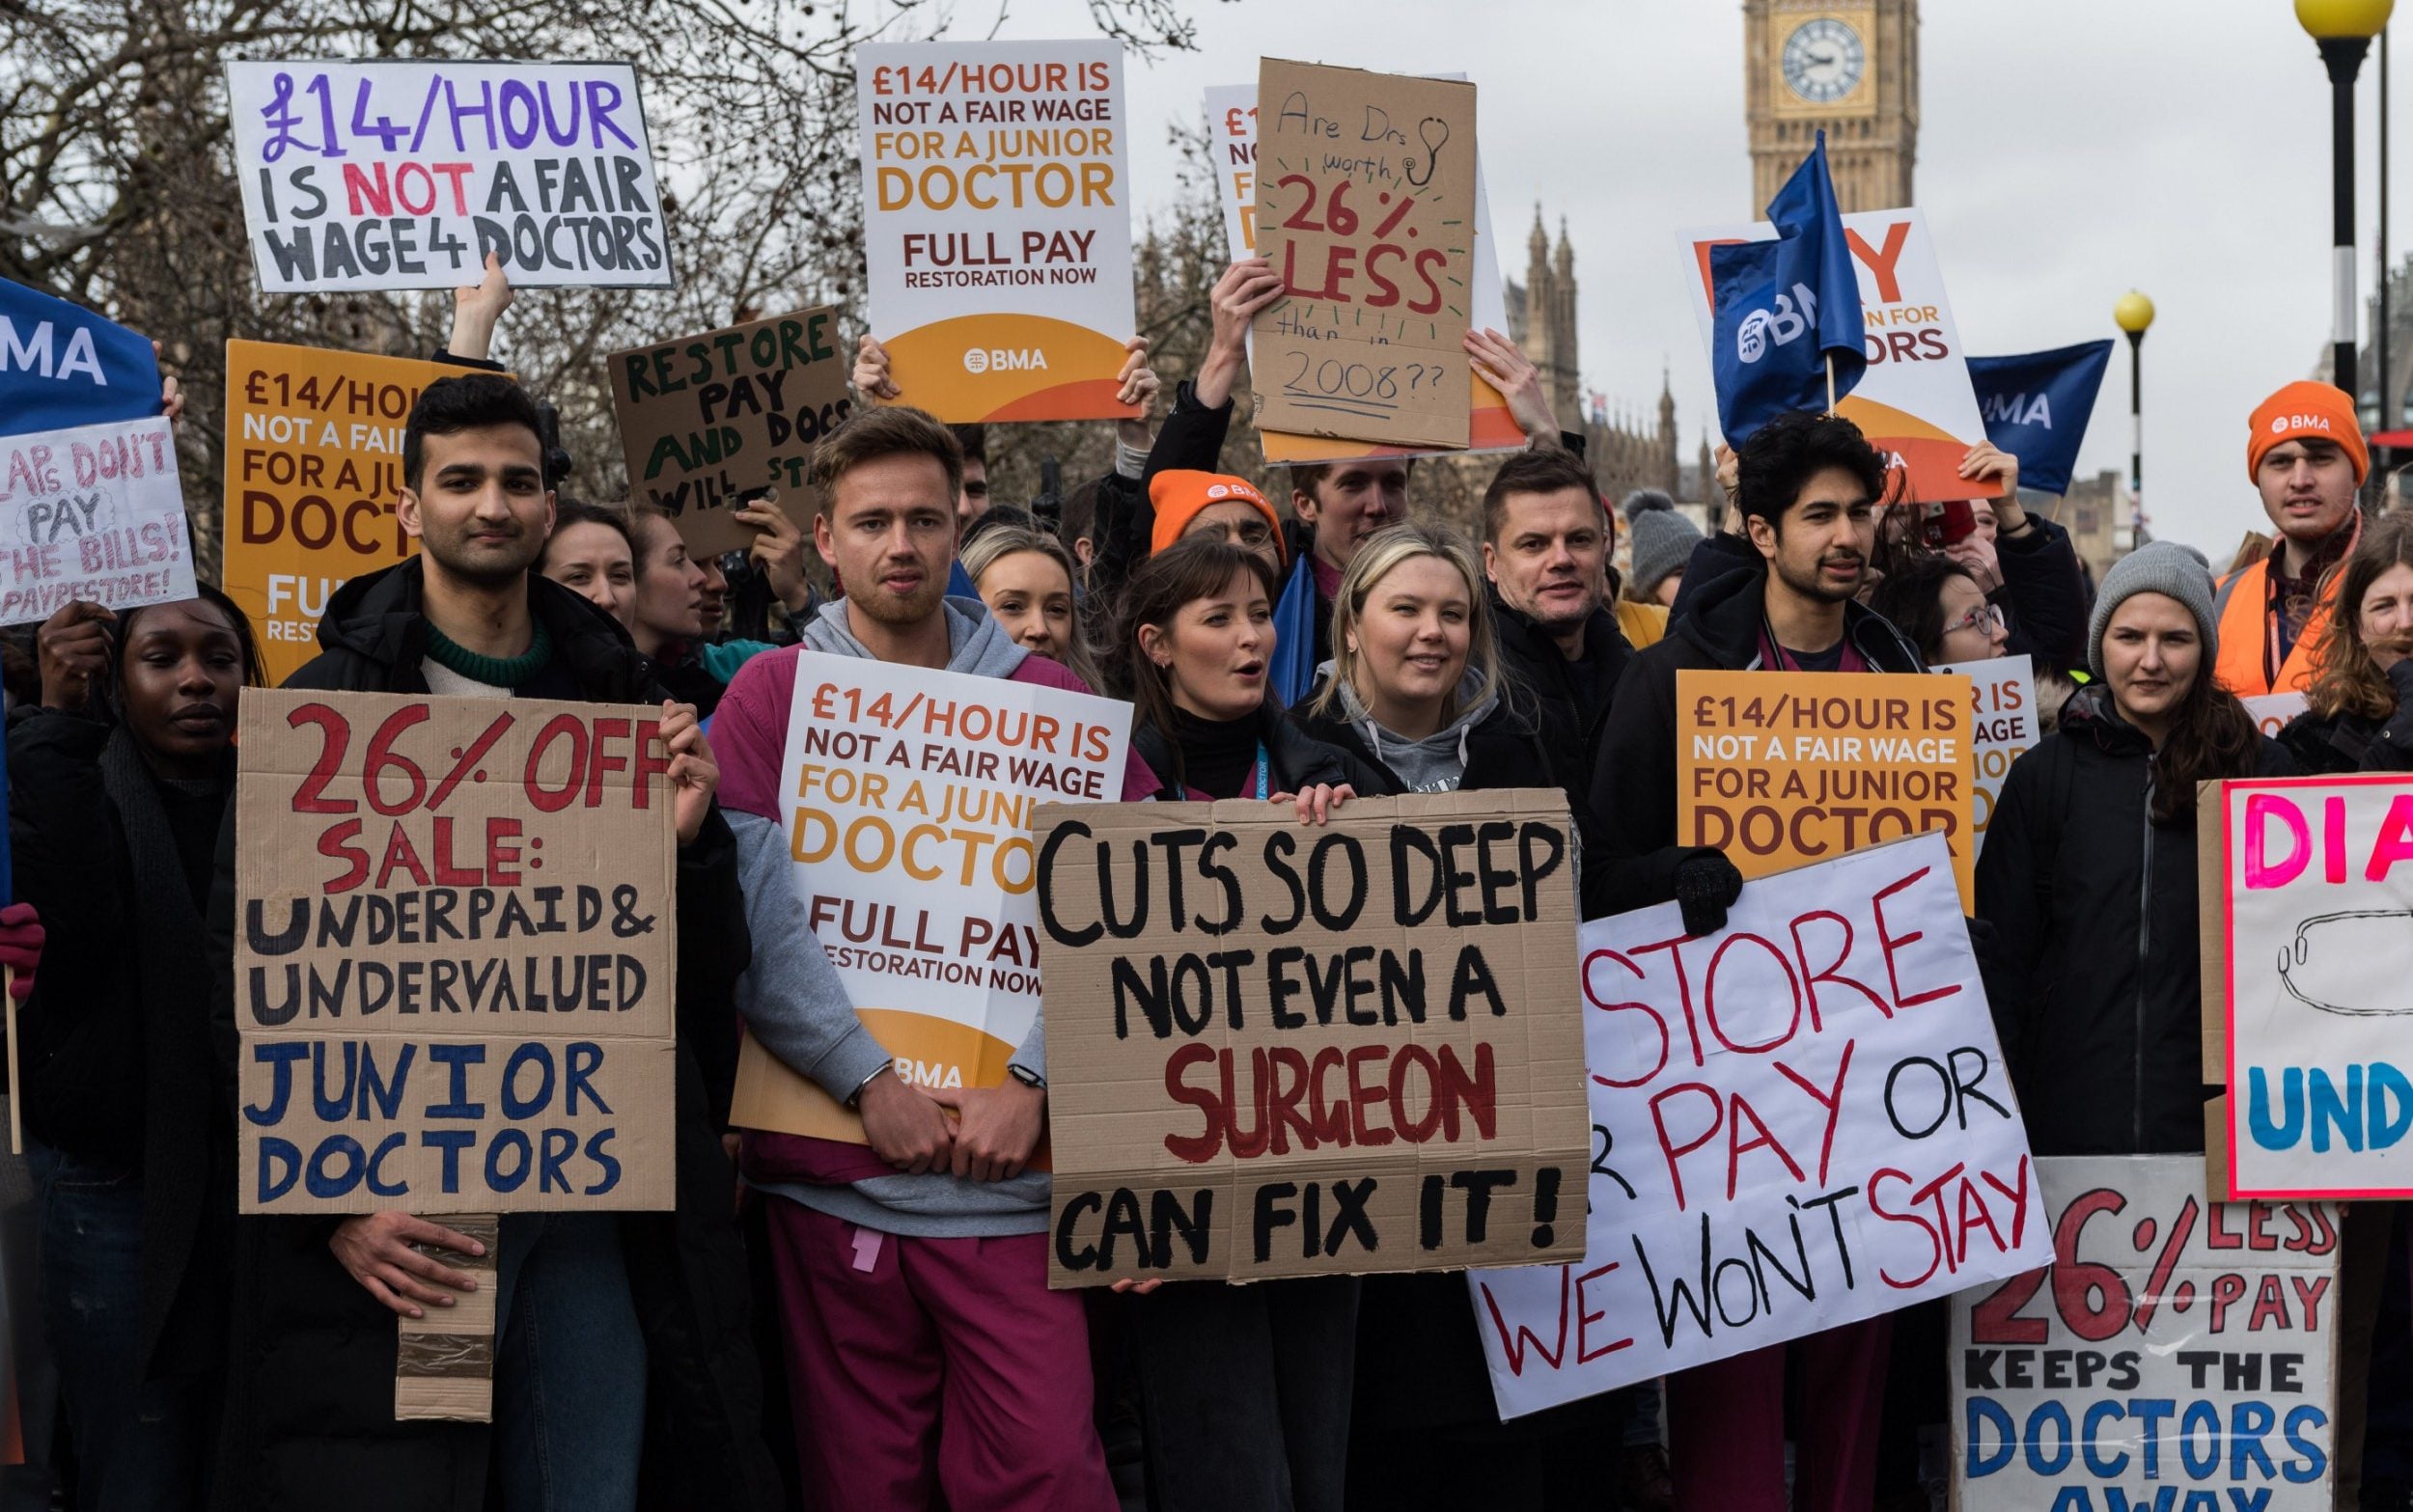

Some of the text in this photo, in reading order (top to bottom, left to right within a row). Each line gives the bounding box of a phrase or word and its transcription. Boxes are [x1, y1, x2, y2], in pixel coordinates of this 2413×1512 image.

[873, 62, 1110, 95] £14/HOUR IS
[261, 72, 638, 162] £14/HOUR
[874, 98, 1112, 124] NOT A FAIR WAGE
[1277, 92, 1340, 138] Are
[1361, 105, 1406, 146] Drs
[874, 128, 1114, 163] FOR A JUNIOR
[1323, 152, 1392, 179] worth
[260, 155, 651, 222] IS NOT A FAIR
[876, 162, 1116, 211] DOCTOR
[1277, 174, 1419, 239] 26%
[263, 212, 662, 282] WAGE 4 DOCTORS
[903, 230, 1096, 266] FULL PAY
[1283, 239, 1448, 315] LESS
[905, 267, 1097, 289] RESTORATION NOW
[1277, 307, 1389, 346] than in
[1890, 305, 1940, 326] FOR
[0, 315, 107, 386] MA
[625, 314, 835, 403] RESTORE
[991, 348, 1047, 371] BMA
[698, 369, 787, 425] PAY
[1982, 393, 2052, 430] MA
[2290, 414, 2331, 432] BMA
[70, 432, 166, 488] DON'T
[244, 413, 407, 454] NOT A FAI
[644, 399, 851, 481] AND DOCS
[243, 448, 324, 488] FOR
[334, 458, 362, 493] A
[648, 455, 816, 518] WILL ST
[27, 493, 100, 544] PAY
[78, 512, 180, 574] BILLS!
[812, 682, 1112, 762] £14/HOUR IS
[1694, 694, 1909, 730] £14/HOUR
[1923, 699, 1956, 731] IS
[1991, 680, 2023, 712] IS
[286, 702, 670, 816] 26% OFF
[805, 727, 1105, 799] NOT A FAIR WAGE
[1693, 735, 1758, 760] NOT
[1764, 736, 1787, 761] A
[1795, 736, 1862, 762] FAIR
[1870, 738, 1956, 764] WAGE
[798, 764, 890, 810] FOR
[898, 785, 929, 815] A
[1694, 767, 1958, 805] FOR A JUNIOR
[318, 816, 542, 894] SALE:
[1036, 819, 1566, 948] CUTS SO DEEP
[246, 884, 656, 955] UNDERPAID &
[810, 894, 945, 954] FULL
[249, 954, 647, 1026] UNDERVALUED
[1110, 944, 1507, 1040] NOT EVEN A
[243, 1040, 613, 1127] JUNIOR
[895, 1057, 962, 1088] BMA
[1164, 1042, 1497, 1163] SURGEON
[1650, 1039, 1855, 1212] PAY
[1884, 1046, 2011, 1140] OR
[258, 1128, 622, 1203] DOCTORS
[1056, 1187, 1213, 1272] CAN
[1254, 1176, 1379, 1263] FIX
[2207, 1199, 2338, 1255] LESS
[1480, 1262, 1635, 1377] WE
[1868, 1154, 2028, 1290] STAY
[2209, 1273, 2332, 1333] PAY
[1964, 1348, 2305, 1392] KEEPS THE
[1966, 1395, 2330, 1484] DOCTORS
